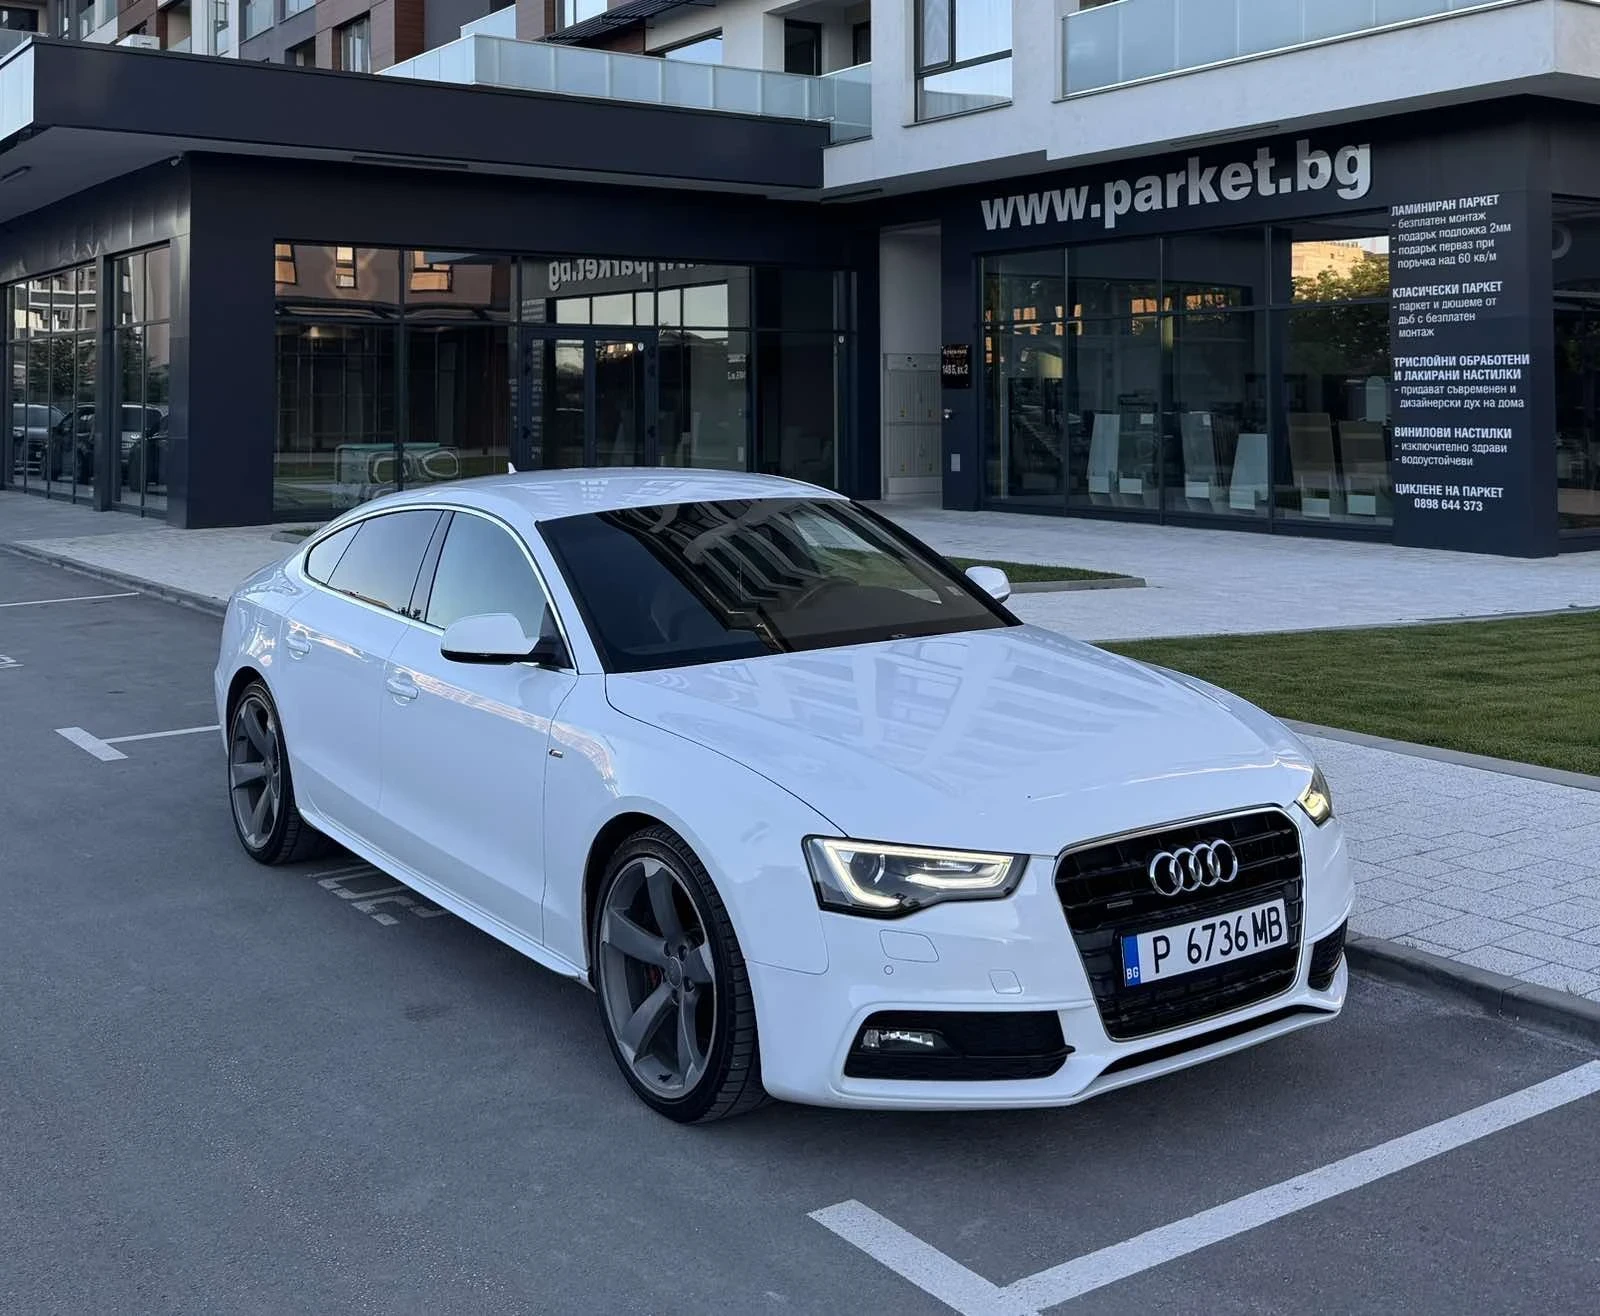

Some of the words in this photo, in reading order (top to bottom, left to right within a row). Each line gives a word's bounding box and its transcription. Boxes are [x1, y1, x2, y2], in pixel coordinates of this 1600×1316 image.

[981, 139, 1371, 231] www.parket.bg
[1391, 200, 1456, 216] ЛАМИНИРАН
[1459, 194, 1499, 208] ПАРКЕТ
[1398, 218, 1446, 229] безплатен
[1449, 212, 1486, 222] монтаж
[1439, 227, 1487, 238] подложка
[1490, 222, 1511, 233] 2мм
[1439, 242, 1473, 254] перваз
[1476, 239, 1494, 250] при
[1439, 255, 1455, 266] над
[1458, 253, 1470, 263] 60
[1474, 251, 1496, 263] кв/м
[1393, 284, 1458, 298] КЛАСИЧЕСКИ
[1462, 281, 1502, 294] ПАРКЕТ
[1399, 302, 1430, 313] паркет
[1442, 300, 1482, 309] дюшеме
[1486, 297, 1496, 306] от
[1418, 315, 1423, 323] с
[1426, 313, 1475, 323] безплатен
[1399, 327, 1434, 338] монтаж
[1394, 355, 1456, 367] ТРИСЛОЙНИ
[1459, 354, 1529, 366] ОБРАБОТЕНИ
[1394, 371, 1401, 380] И
[1404, 370, 1460, 380] ЛАКИРАНИ
[1463, 369, 1521, 380] НАСТИЛКИ
[1401, 385, 1444, 395] придават
[1510, 385, 1516, 393] и
[1400, 398, 1461, 410] дизайнерски
[1464, 400, 1480, 410] дух
[1483, 399, 1495, 408] на
[1497, 399, 1524, 409] дома
[1395, 427, 1450, 437] ВИНИЛОВИ
[1454, 428, 1512, 439] НАСТИЛКИ
[1402, 442, 1468, 452] изключително
[1472, 444, 1507, 454] здрави
[1402, 455, 1473, 466] водоустойчеви
[1395, 484, 1442, 496] ЦИКЛЕНЕ
[1445, 486, 1460, 496] НА
[1463, 487, 1503, 498] ПАРКЕТ
[1414, 498, 1438, 509] 0898
[1442, 500, 1460, 510] 644
[1463, 501, 1483, 511] 373
[1152, 935, 1170, 974] P
[1187, 915, 1248, 965] 6736
[1252, 906, 1283, 948] MB
[1126, 966, 1140, 980] BG
